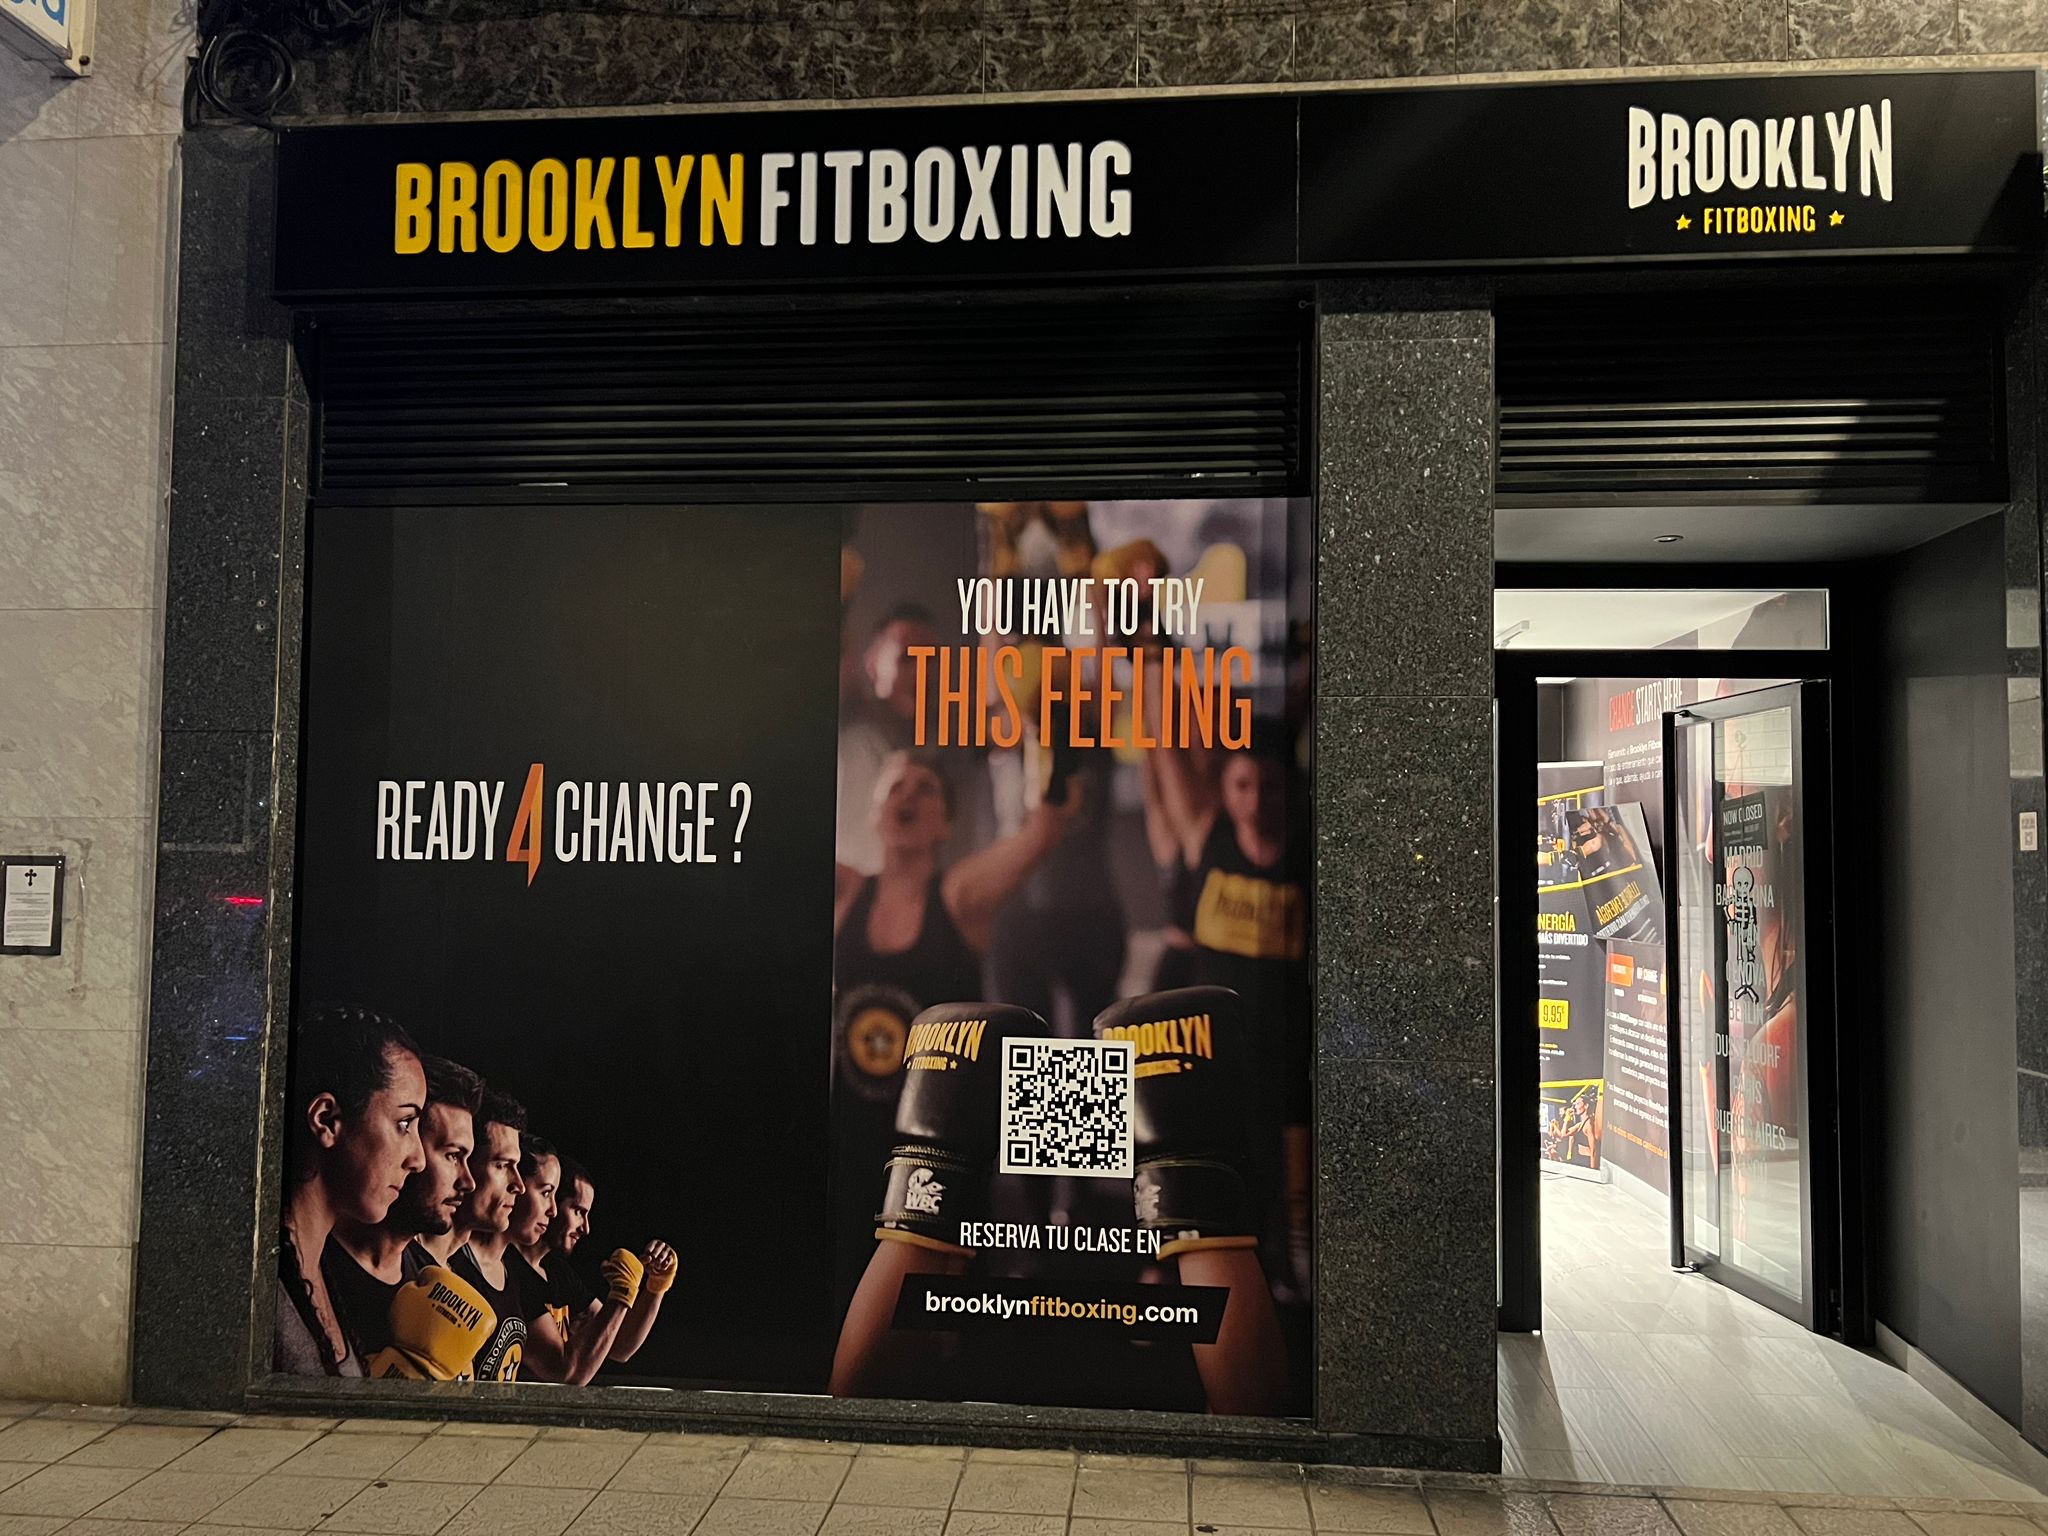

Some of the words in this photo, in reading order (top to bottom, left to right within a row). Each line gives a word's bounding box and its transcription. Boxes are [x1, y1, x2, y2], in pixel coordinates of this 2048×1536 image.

[1628, 98, 1893, 210] BROOKLYN
[395, 152, 744, 254] BROOKLYN
[760, 140, 1132, 246] FITBOXING
[1703, 204, 1816, 234] FITBOXING
[957, 578, 1013, 635] YOU
[1022, 578, 1095, 635] HAVE
[1103, 577, 1139, 635] TO
[1148, 578, 1204, 635] TRY
[907, 645, 1023, 747] THIS
[1040, 645, 1252, 749] FEELING
[1609, 689, 1635, 733] CHANGE
[1635, 680, 1662, 725] STARTS
[376, 780, 504, 861] READY
[506, 763, 544, 888] 4
[555, 781, 719, 863] CHANGE
[1723, 809, 1738, 826] NOW
[1738, 803, 1763, 823] CLOSED
[1724, 845, 1764, 868] MADRID
[1715, 883, 1775, 909] BARCELONA
[1553, 933, 1588, 947] DIVERTIDO
[1755, 1119, 1786, 1151] AIRES
[960, 1221, 1041, 1249] RESERVA
[1045, 1225, 1069, 1251] TU
[1074, 1227, 1131, 1253] CLASE
[1136, 1230, 1161, 1254] EN
[427, 1281, 484, 1332] BROOKLYN
[925, 1291, 1198, 1326] brooklynfitboxing.com
